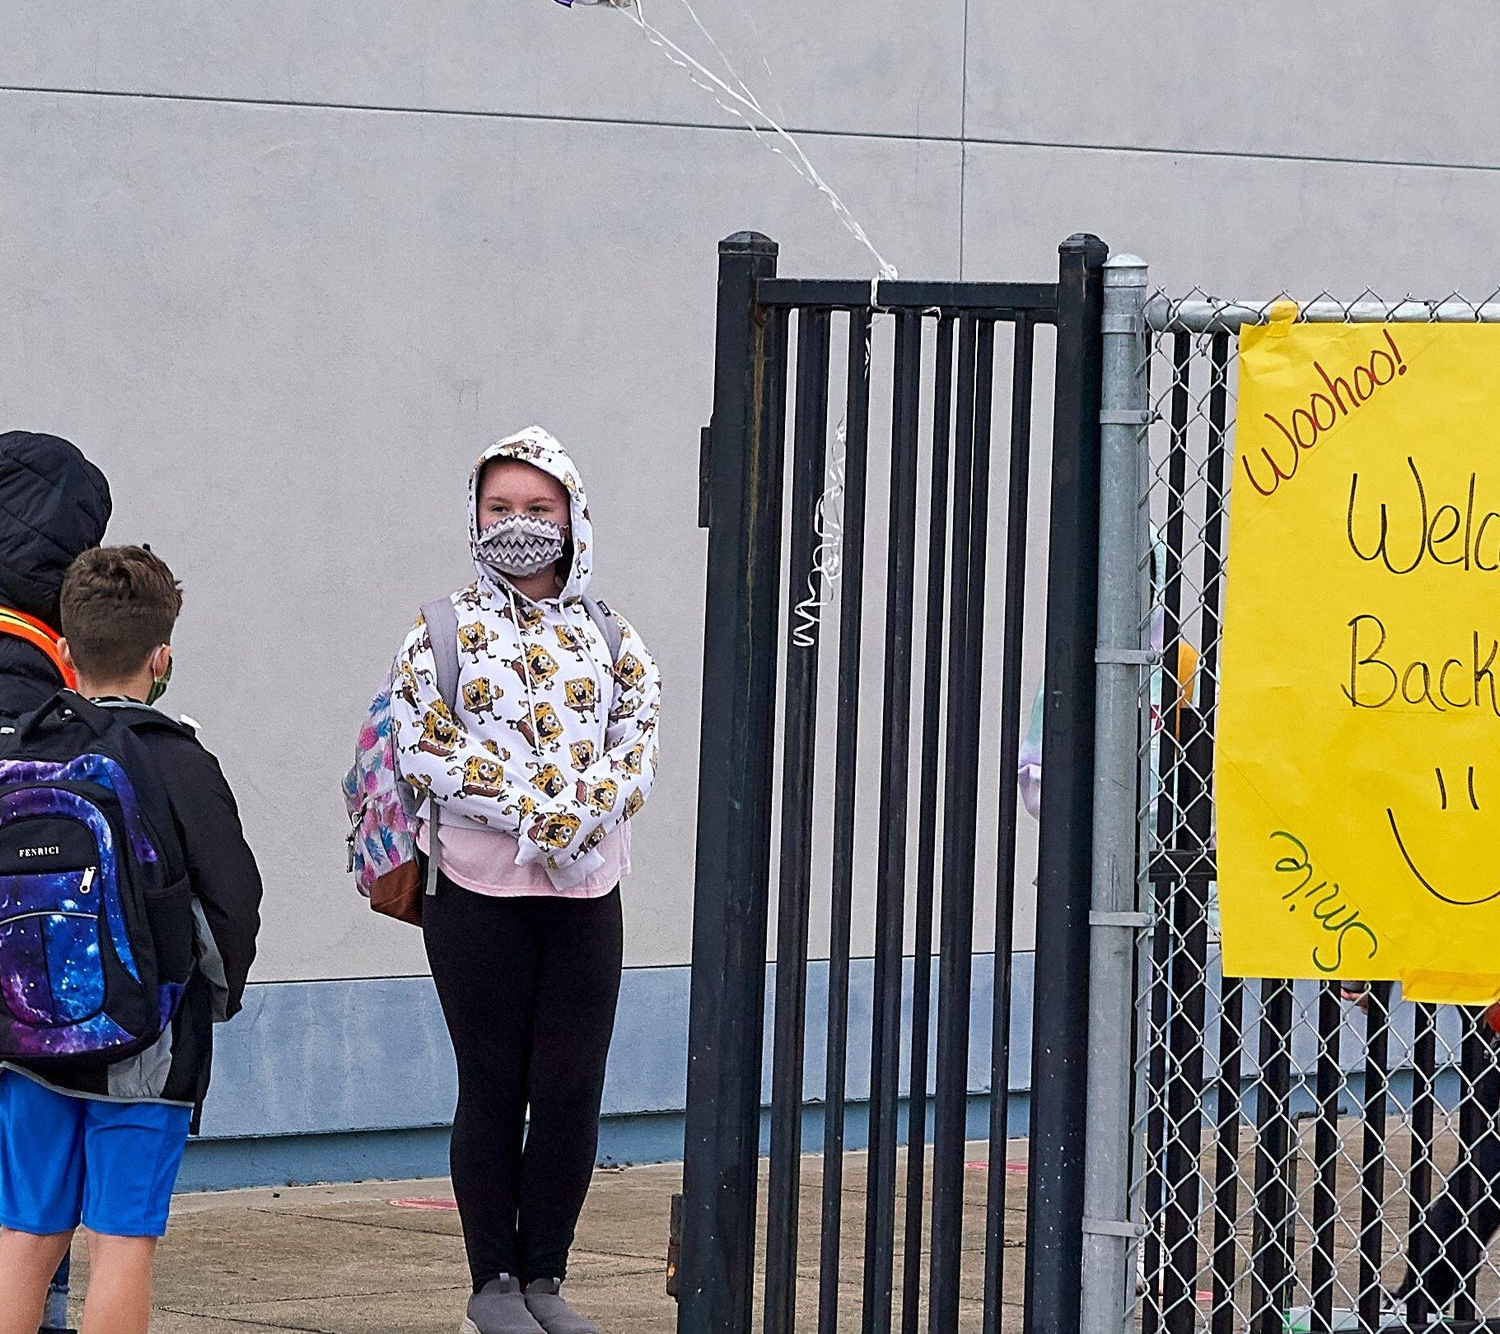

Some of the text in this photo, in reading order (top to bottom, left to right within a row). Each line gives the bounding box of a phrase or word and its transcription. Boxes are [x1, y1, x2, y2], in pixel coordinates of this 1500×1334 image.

[1242, 328, 1407, 496] Woohoo!
[18, 845, 60, 858] FENRICI
[1270, 830, 1378, 973] Smile
